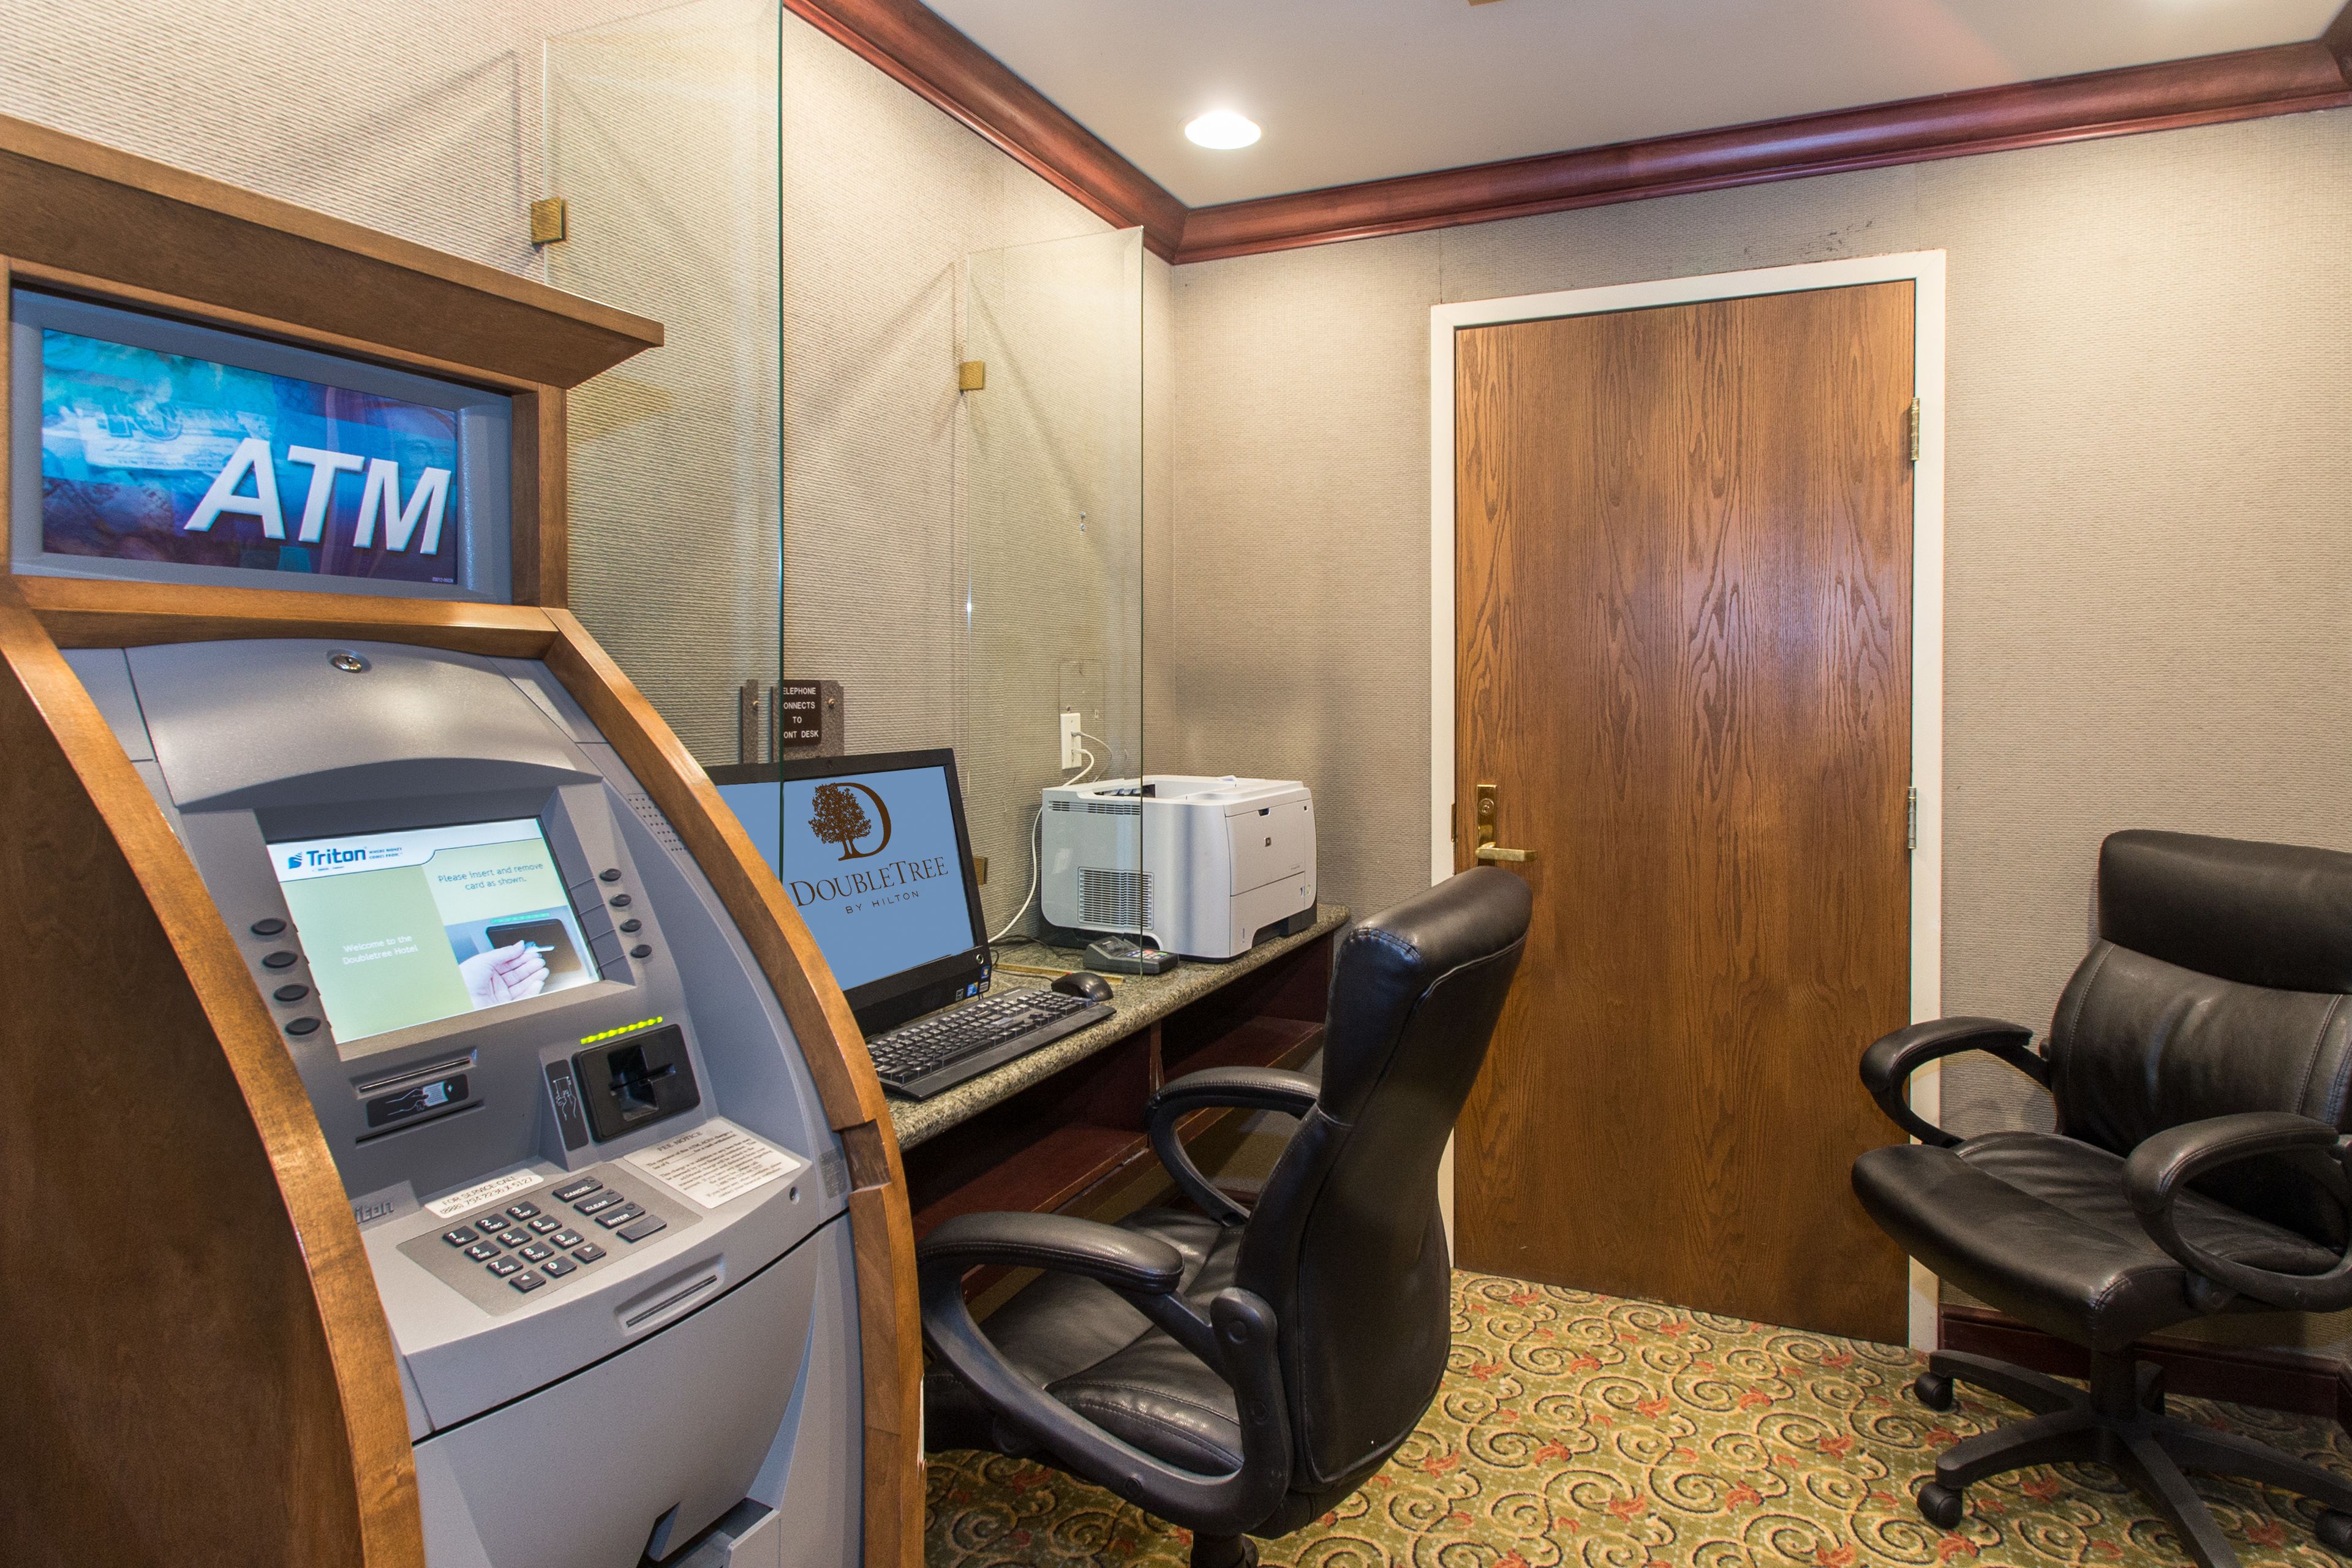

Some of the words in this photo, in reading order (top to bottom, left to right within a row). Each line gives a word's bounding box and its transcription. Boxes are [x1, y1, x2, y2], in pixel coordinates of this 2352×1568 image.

[184, 437, 452, 555] ATM
[801, 729, 820, 738] DESK
[306, 848, 366, 867] Triton
[437, 873, 467, 883] Please
[469, 869, 495, 879] insert
[497, 866, 512, 875] and
[514, 862, 544, 872] remove
[465, 881, 485, 890] card
[498, 876, 527, 886] shown.
[845, 903, 862, 914] BY
[872, 890, 919, 908] HILTON
[343, 940, 385, 952] Welcome
[343, 951, 393, 965] Doubletree
[394, 944, 419, 955] Hotel
[657, 1142, 674, 1152] FEE
[674, 1131, 703, 1145] NOTICE
[512, 1177, 533, 1187] 5127
[442, 1196, 462, 1205] FOR
[461, 1183, 496, 1199] SERVICE
[496, 1175, 517, 1186] CALL
[564, 1185, 591, 1198] CANCEL
[586, 1200, 608, 1210] CLEAR
[607, 1213, 630, 1225] ENTER
[532, 1251, 545, 1260] TUV
